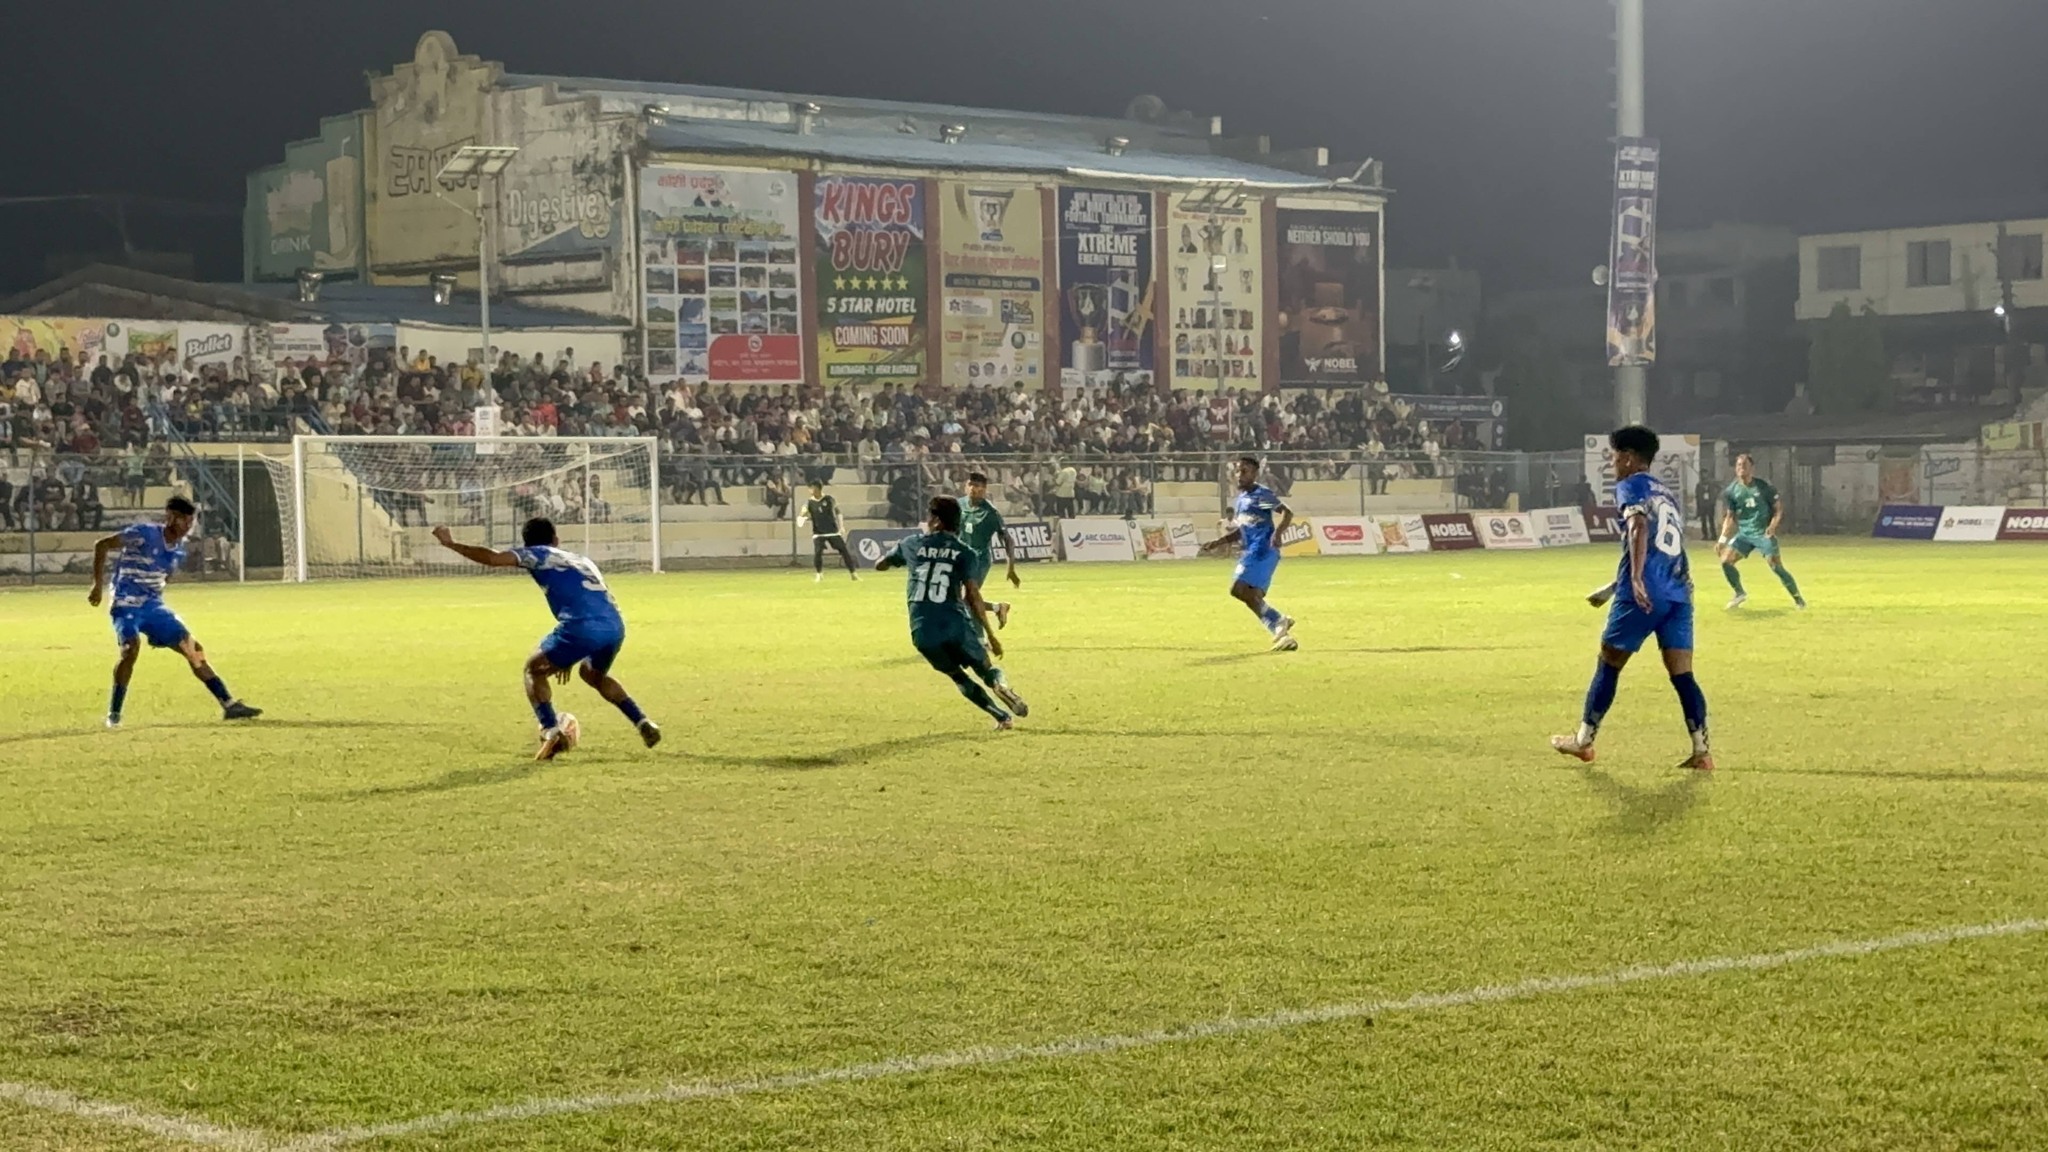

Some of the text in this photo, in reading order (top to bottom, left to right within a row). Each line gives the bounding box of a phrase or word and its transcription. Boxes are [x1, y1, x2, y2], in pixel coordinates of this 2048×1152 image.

[510, 184, 598, 240] Digestive
[822, 182, 915, 226] KINGS
[1065, 210, 1147, 225] FOOTBALL TOURNAMENT
[1078, 233, 1137, 254] XTREME
[1287, 229, 1371, 247] NEITHER SHOULD YOU
[832, 229, 911, 274] BURY
[1078, 253, 1110, 266] ENERGY
[827, 297, 917, 314] 5 STAR HOTEL
[185, 333, 232, 358] Bullet
[835, 326, 909, 346] COMING SOON
[1324, 358, 1358, 369] NOBEL
[1280, 521, 1313, 546] ullet
[1429, 523, 1472, 537] NOBEL
[1655, 499, 1684, 557] 6
[916, 546, 961, 560] ARMY
[914, 561, 953, 604] 15
